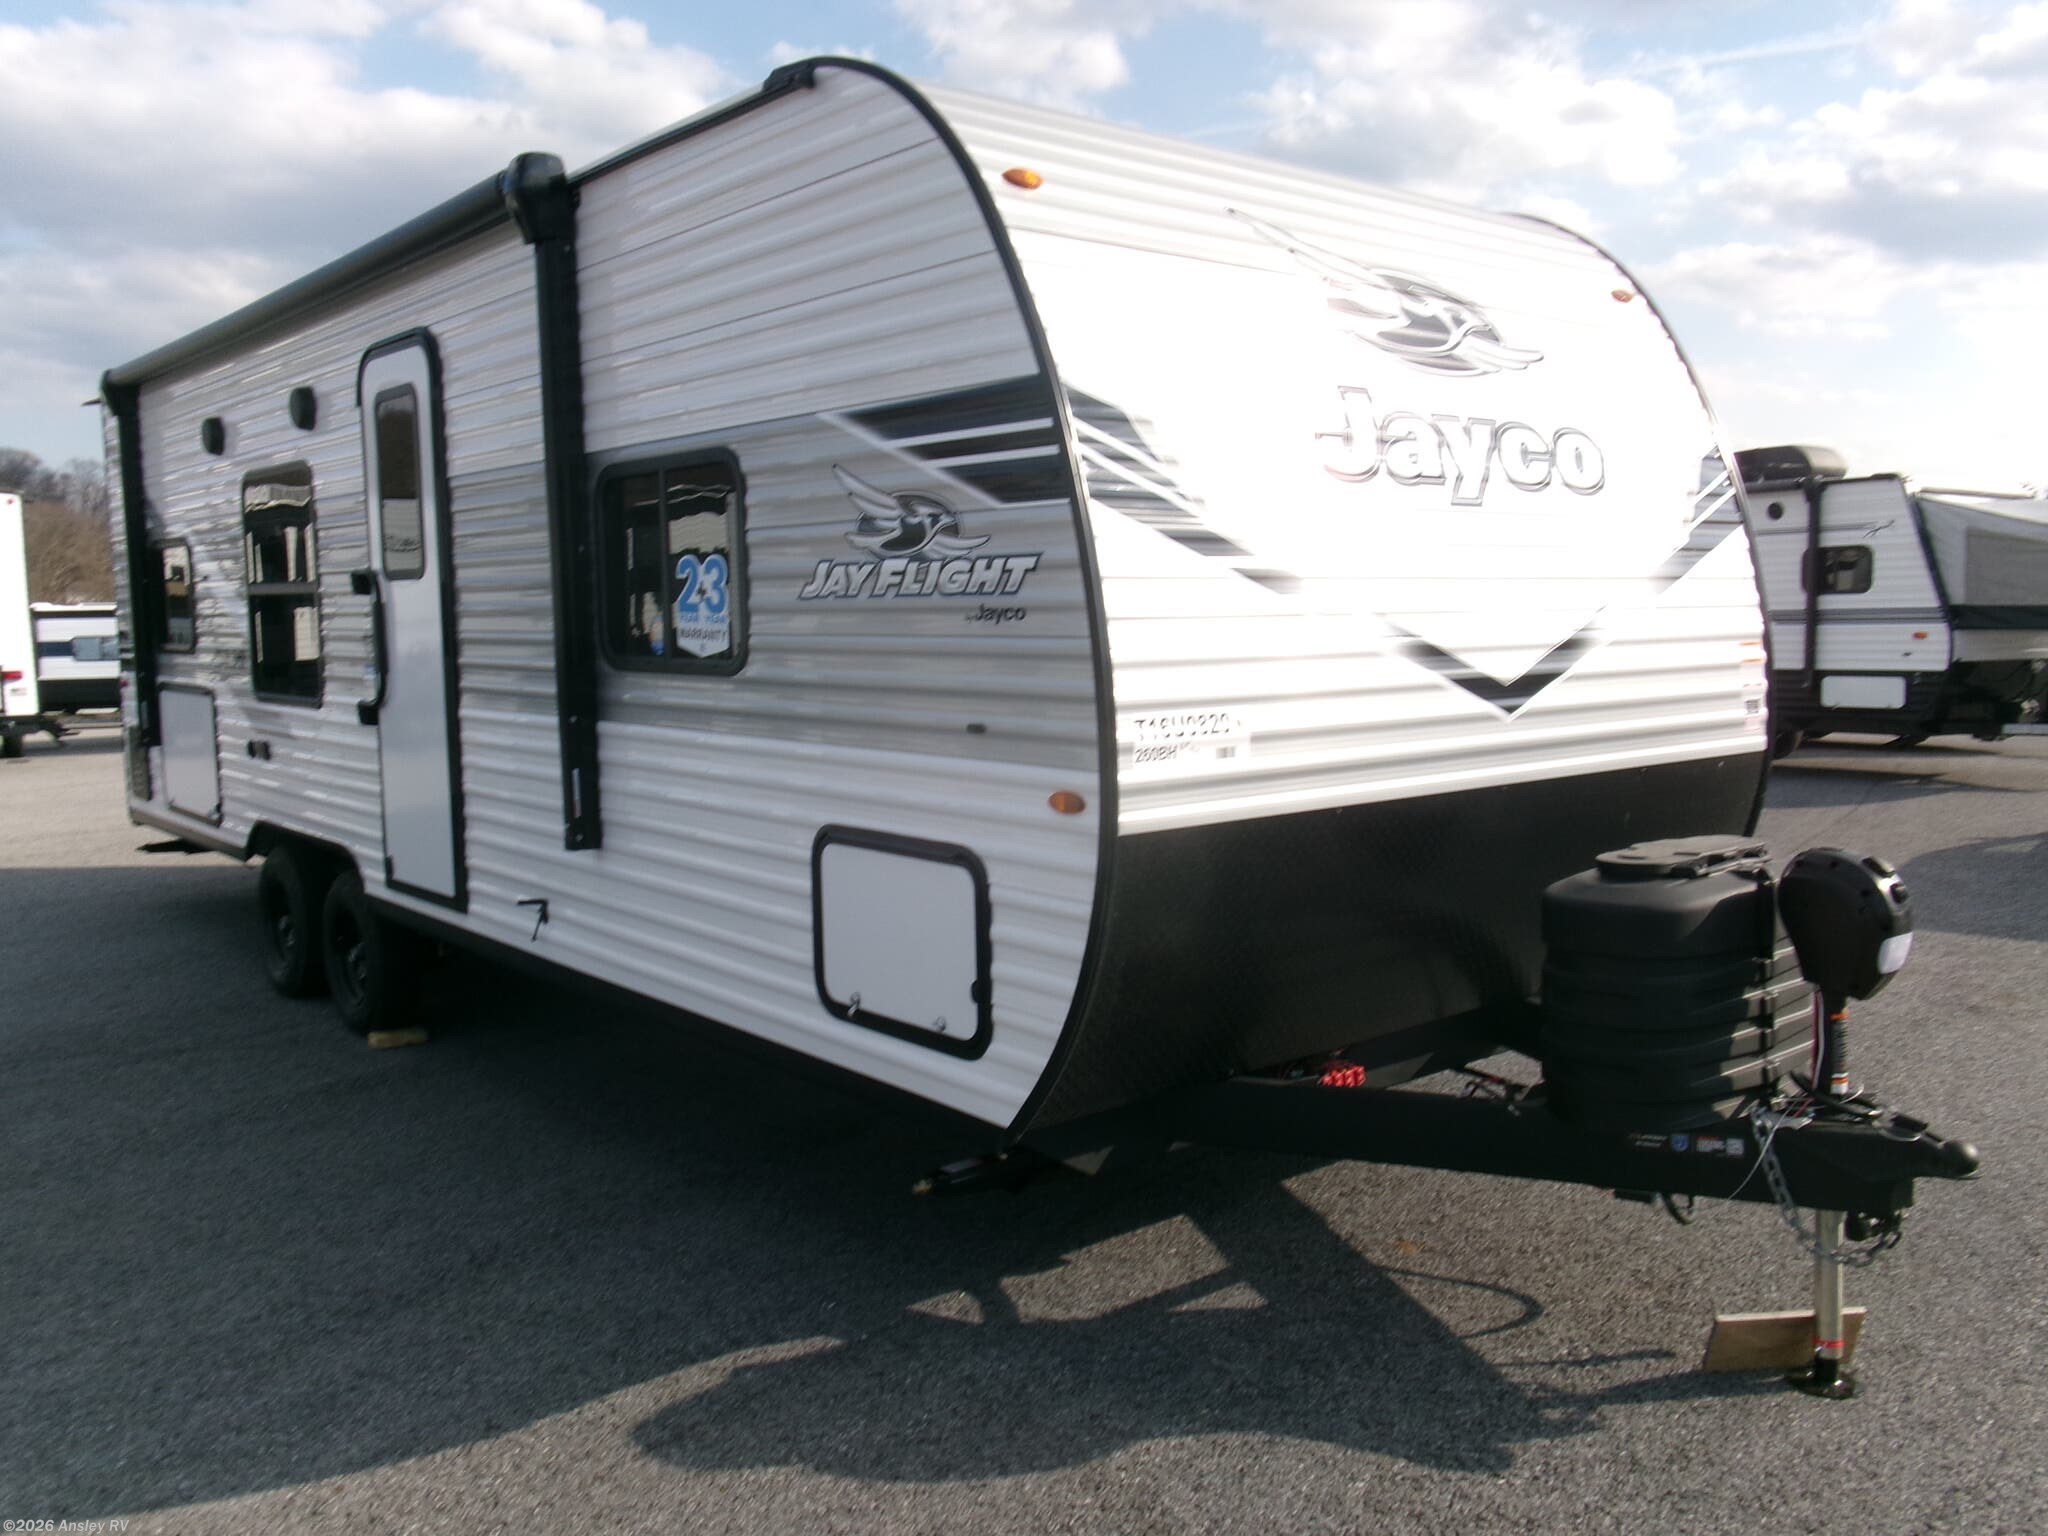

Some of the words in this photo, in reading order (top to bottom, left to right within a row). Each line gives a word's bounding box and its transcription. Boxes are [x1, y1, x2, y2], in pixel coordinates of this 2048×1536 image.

[1314, 385, 1606, 507] Jayco
[798, 559, 879, 600] JAY
[867, 553, 1045, 599] FLIGHT
[976, 603, 1026, 625] Jayco
